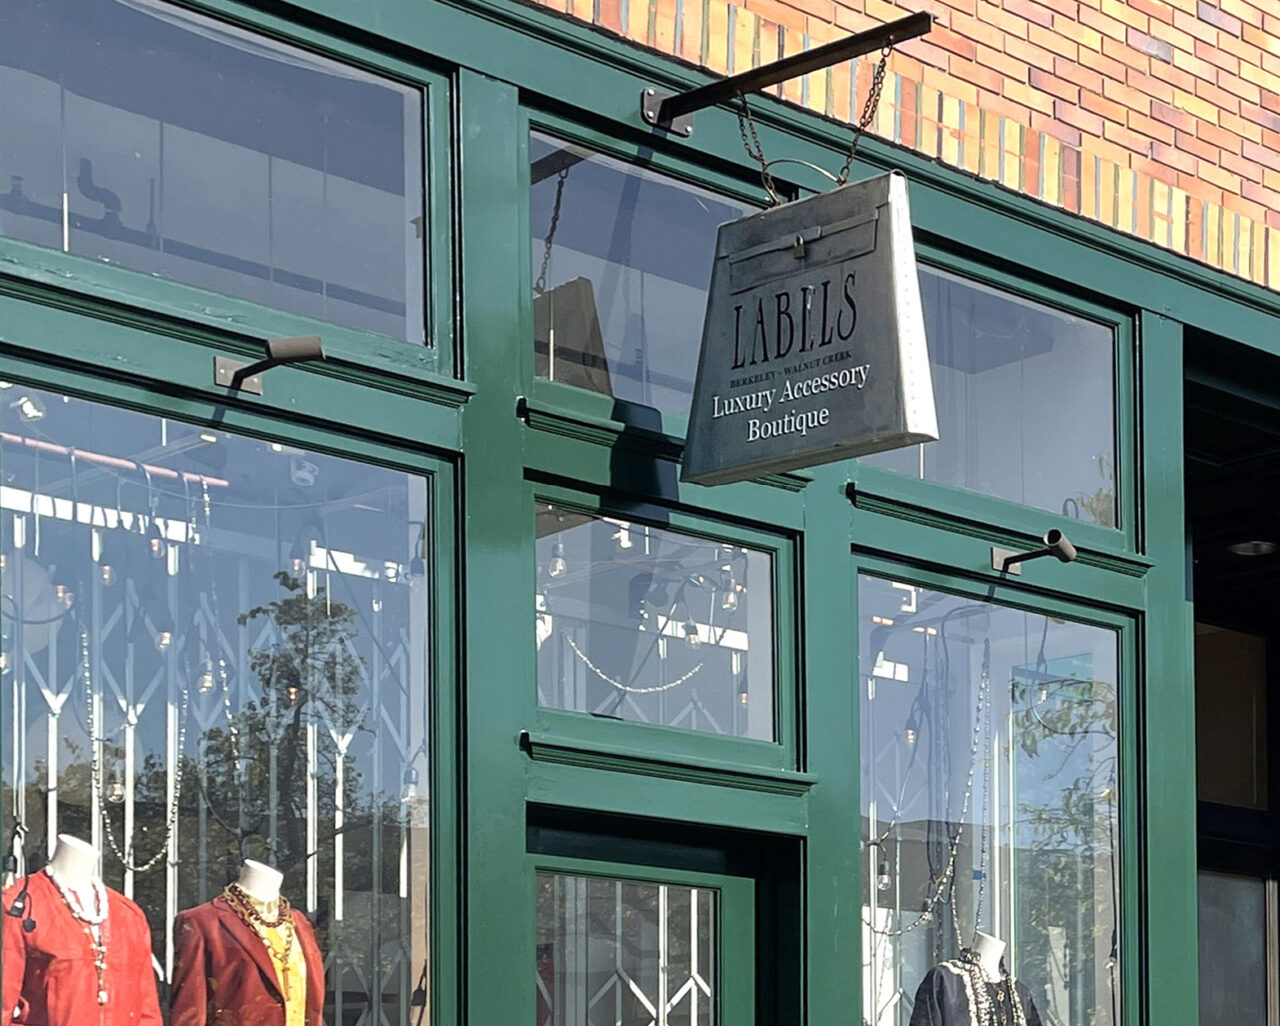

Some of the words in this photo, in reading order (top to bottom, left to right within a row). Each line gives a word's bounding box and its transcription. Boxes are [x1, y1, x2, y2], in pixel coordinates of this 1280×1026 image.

[731, 269, 858, 370] LABELS
[712, 387, 777, 419] Luxury
[779, 363, 871, 404] Accessory
[730, 371, 776, 389] BERKELEY
[784, 358, 821, 375] WALNUT
[822, 350, 853, 367] CREEK
[747, 407, 830, 442] Boutique
